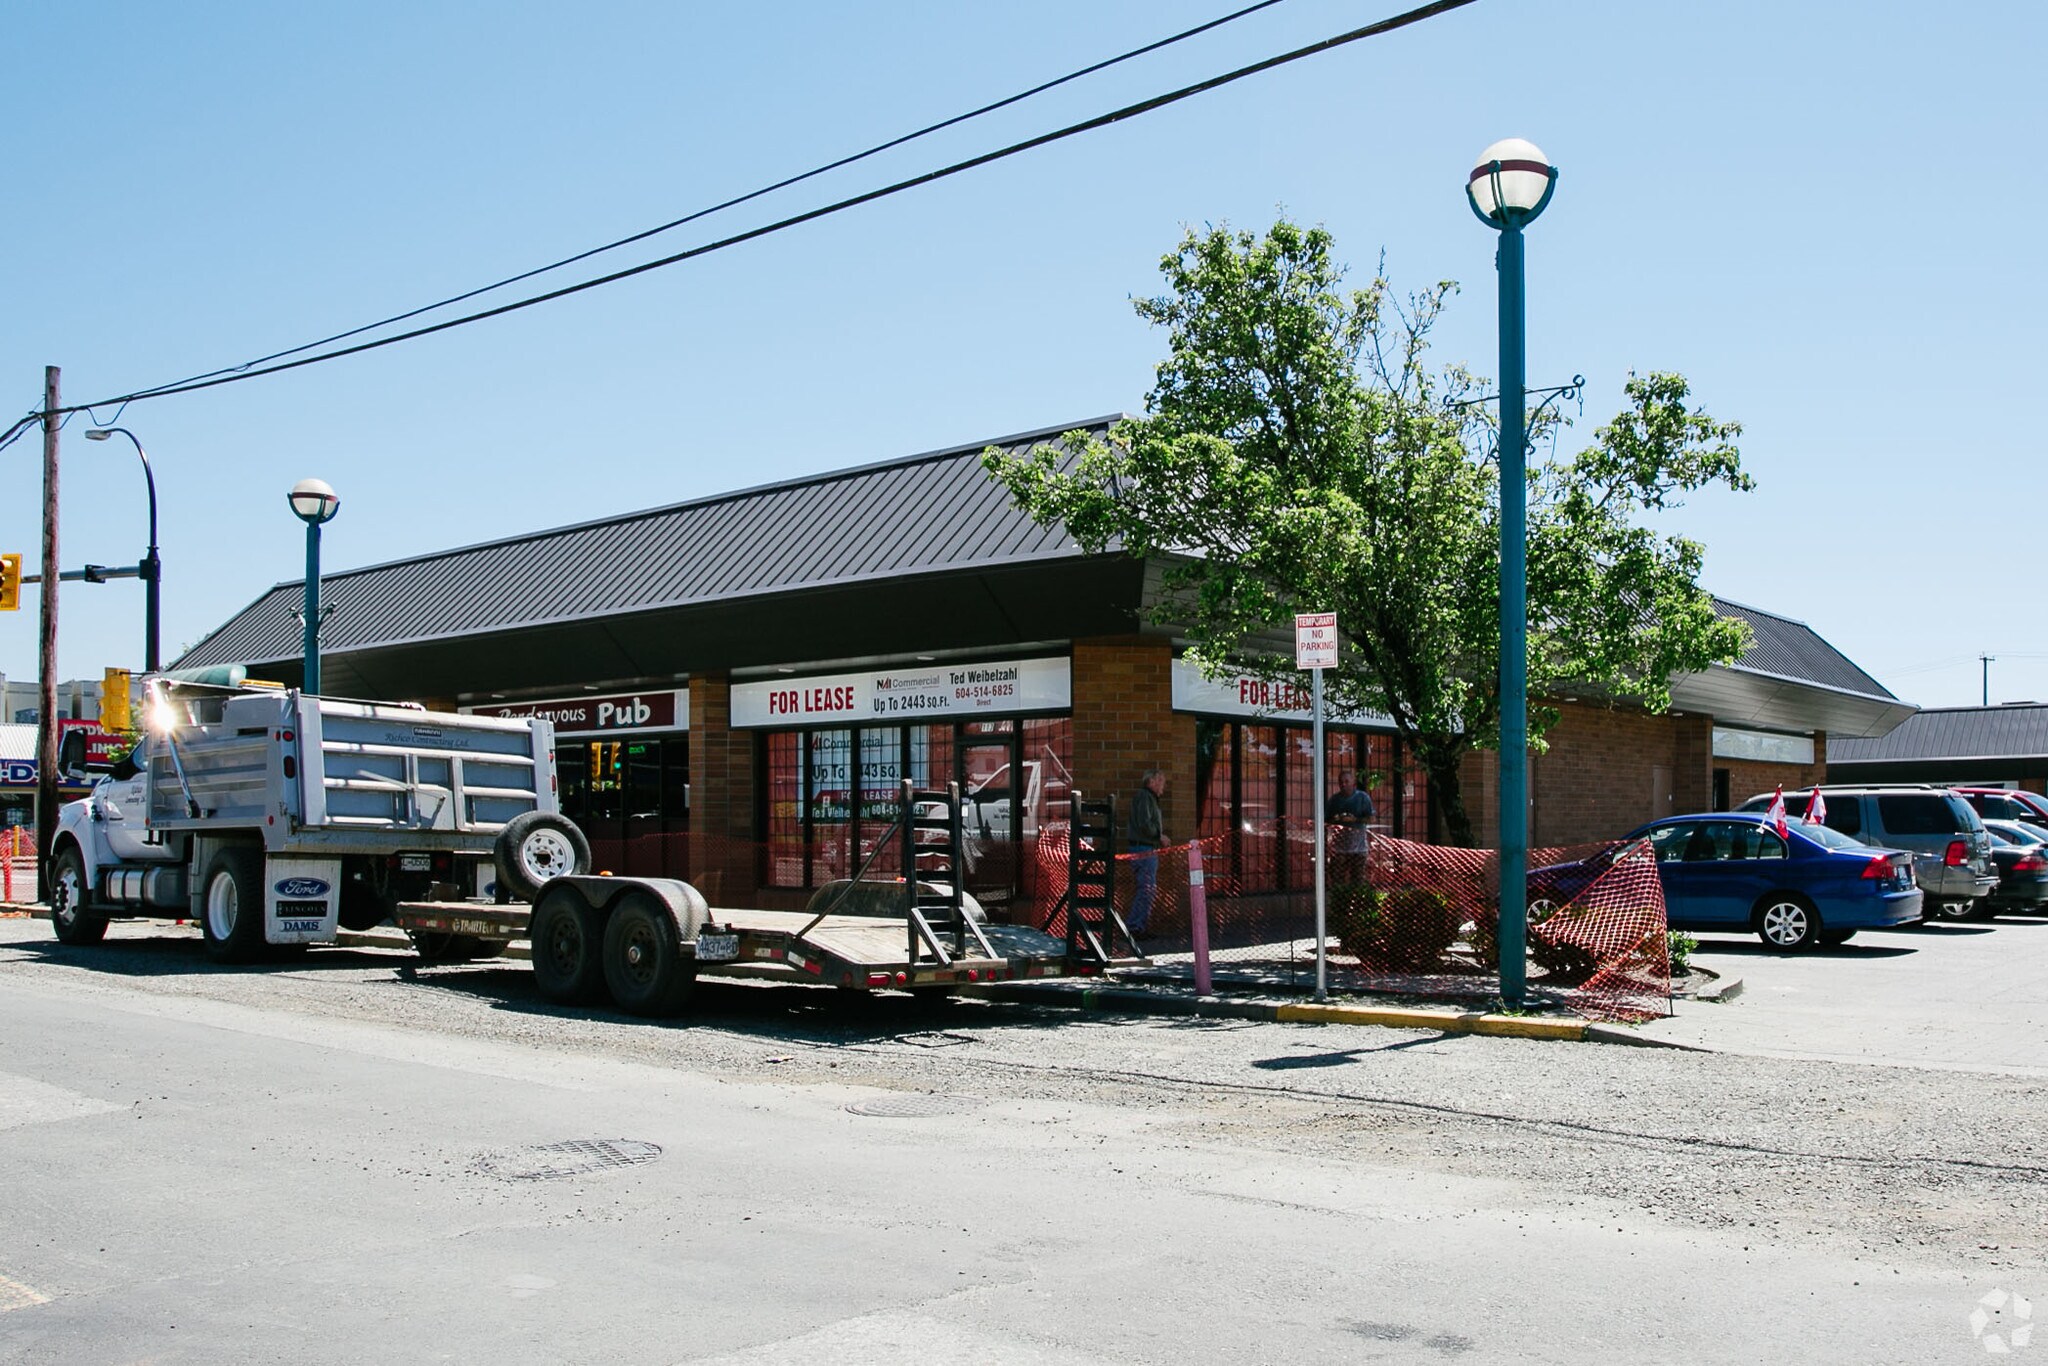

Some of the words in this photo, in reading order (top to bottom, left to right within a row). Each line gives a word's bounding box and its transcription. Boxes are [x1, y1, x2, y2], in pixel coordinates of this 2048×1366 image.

[1298, 616, 1334, 627] TEMPORARY
[1311, 629, 1324, 639] NO
[1300, 641, 1334, 651] PARKING
[892, 675, 940, 687] Commercial
[949, 672, 965, 685] Ted
[968, 667, 1017, 683] Weibelzahl
[955, 684, 1013, 699] 604-514-6825
[1240, 679, 1270, 706] FOR
[1275, 683, 1313, 711] LEAS
[769, 690, 799, 714] FOR
[805, 686, 855, 712] LEASE
[873, 698, 885, 714] Up
[888, 697, 899, 711] To
[901, 694, 926, 710] 2443
[598, 697, 651, 726] Pub
[823, 735, 882, 750] Comrcial
[812, 764, 828, 783] Up
[831, 764, 845, 779] To
[864, 789, 894, 801] LEASE
[285, 880, 320, 894] Ford
[283, 921, 319, 932] DAMS
